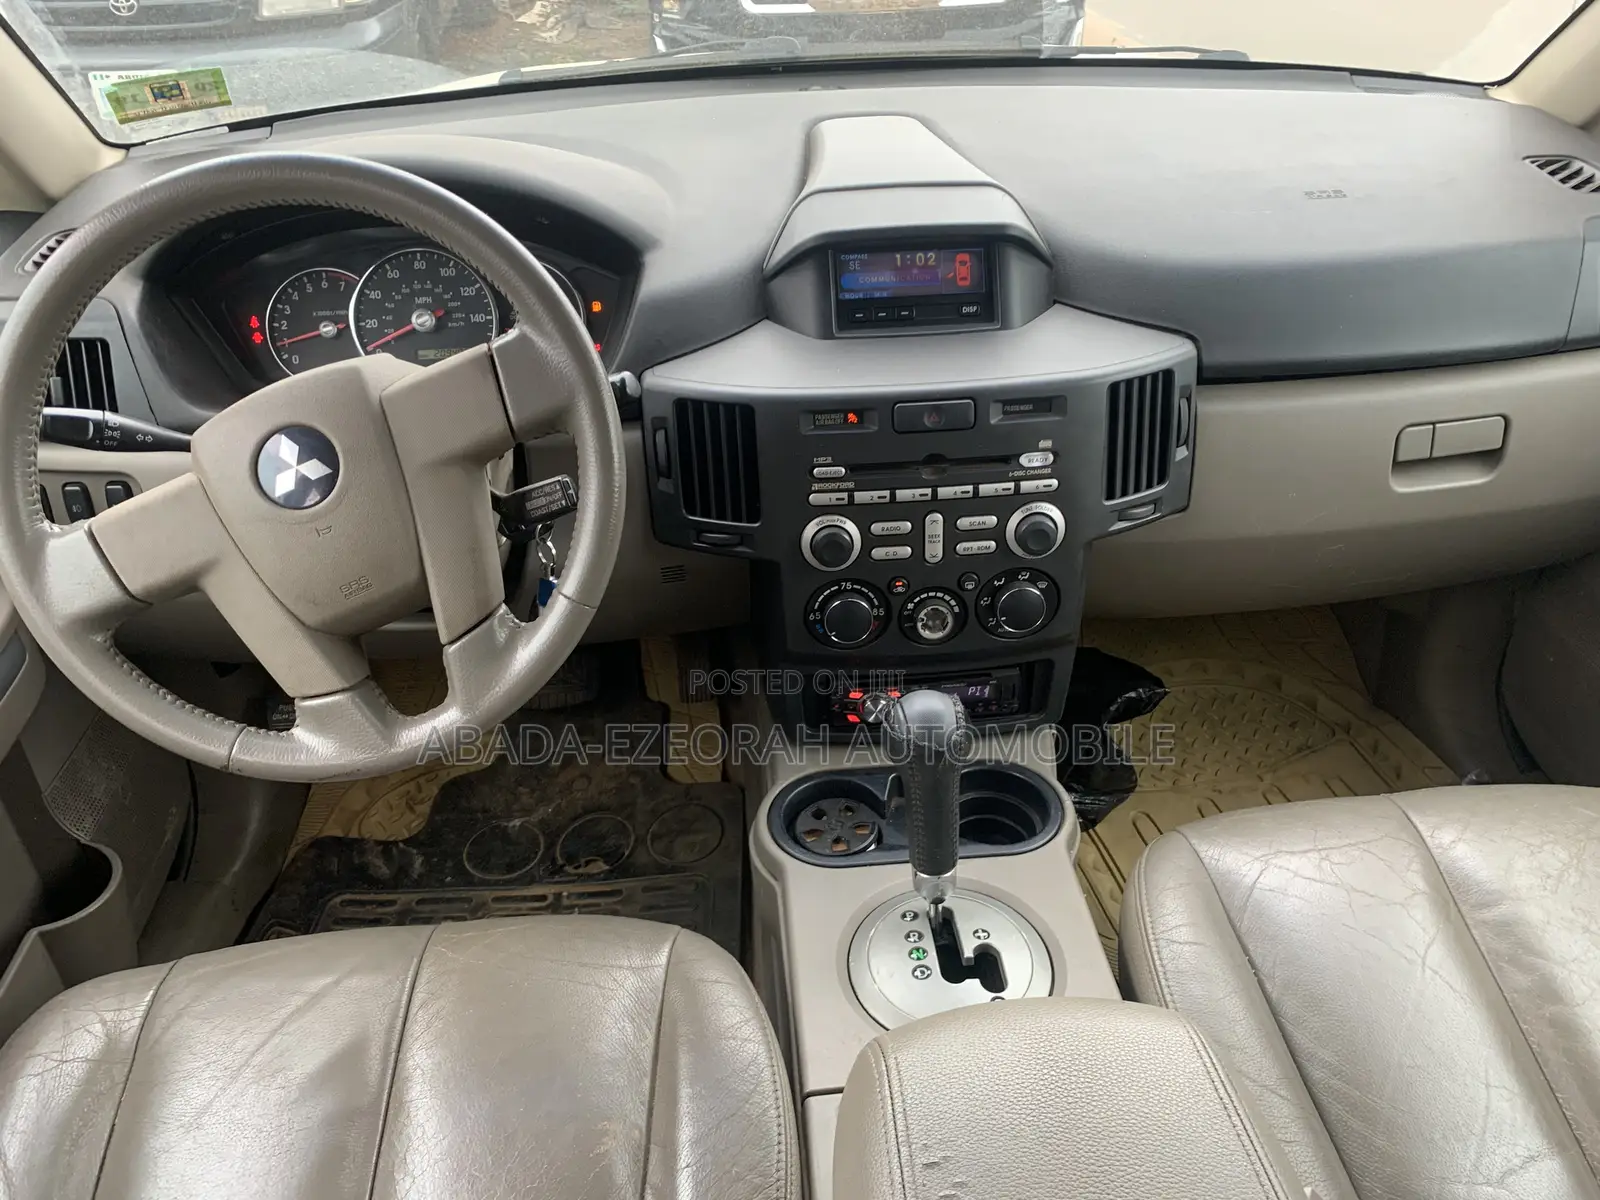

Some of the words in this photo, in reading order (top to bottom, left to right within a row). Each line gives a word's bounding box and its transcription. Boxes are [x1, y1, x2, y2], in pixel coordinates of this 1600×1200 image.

[413, 261, 426, 269] 80
[849, 261, 861, 270] SE
[387, 270, 400, 279] 60
[440, 267, 456, 277] 100
[306, 283, 313, 293] 5
[321, 281, 328, 289] 6
[339, 281, 345, 291] 7
[369, 290, 382, 300] 40
[460, 286, 476, 296] 120
[292, 291, 299, 301] 4
[415, 296, 432, 304] MPH
[284, 305, 291, 314] 3
[469, 313, 486, 323] 140
[281, 320, 288, 330] 2
[365, 319, 378, 328] 20
[292, 355, 299, 364] 0
[840, 581, 852, 590] 75
[809, 611, 821, 620] 65
[872, 608, 885, 616] 85
